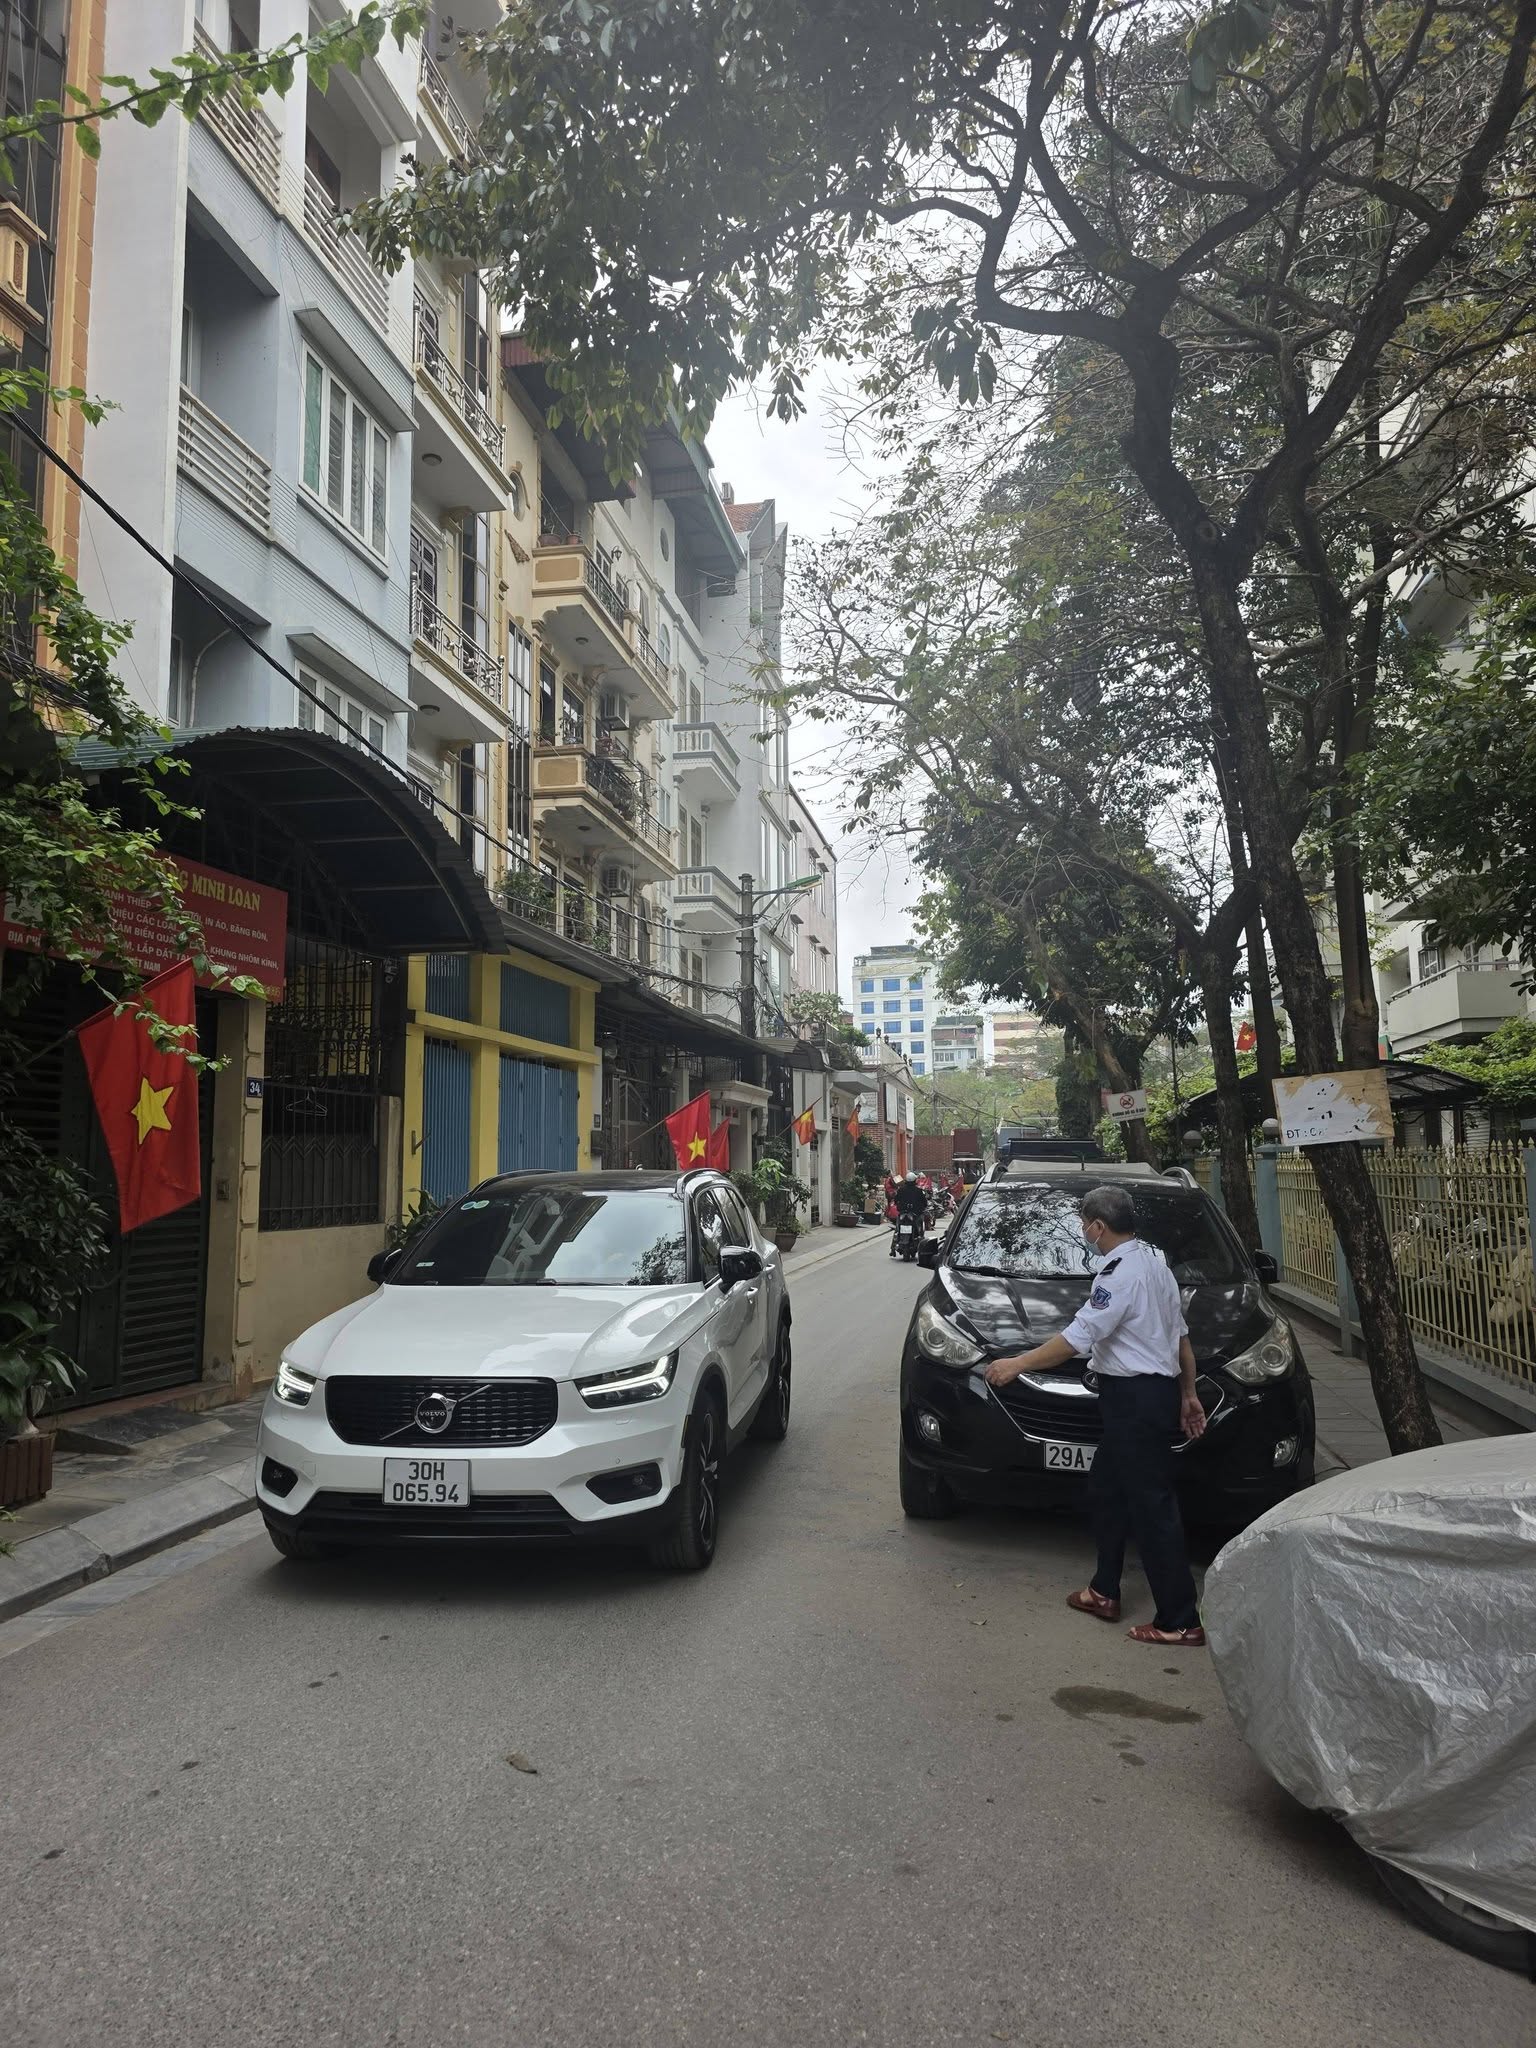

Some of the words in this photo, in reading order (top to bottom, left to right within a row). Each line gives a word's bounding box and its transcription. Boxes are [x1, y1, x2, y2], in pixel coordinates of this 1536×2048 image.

[192, 873, 225, 902] MINH
[228, 885, 261, 912] LOAN
[136, 913, 155, 926] CÁC
[206, 916, 214, 927] IN
[8, 930, 23, 944] ĐỊA
[144, 960, 161, 972] NAM
[156, 947, 173, 960] ĐẶT
[210, 946, 237, 960] KHUNG
[250, 1081, 260, 1094] 34
[408, 1462, 445, 1481] 30H
[393, 1483, 459, 1503] 065.94
